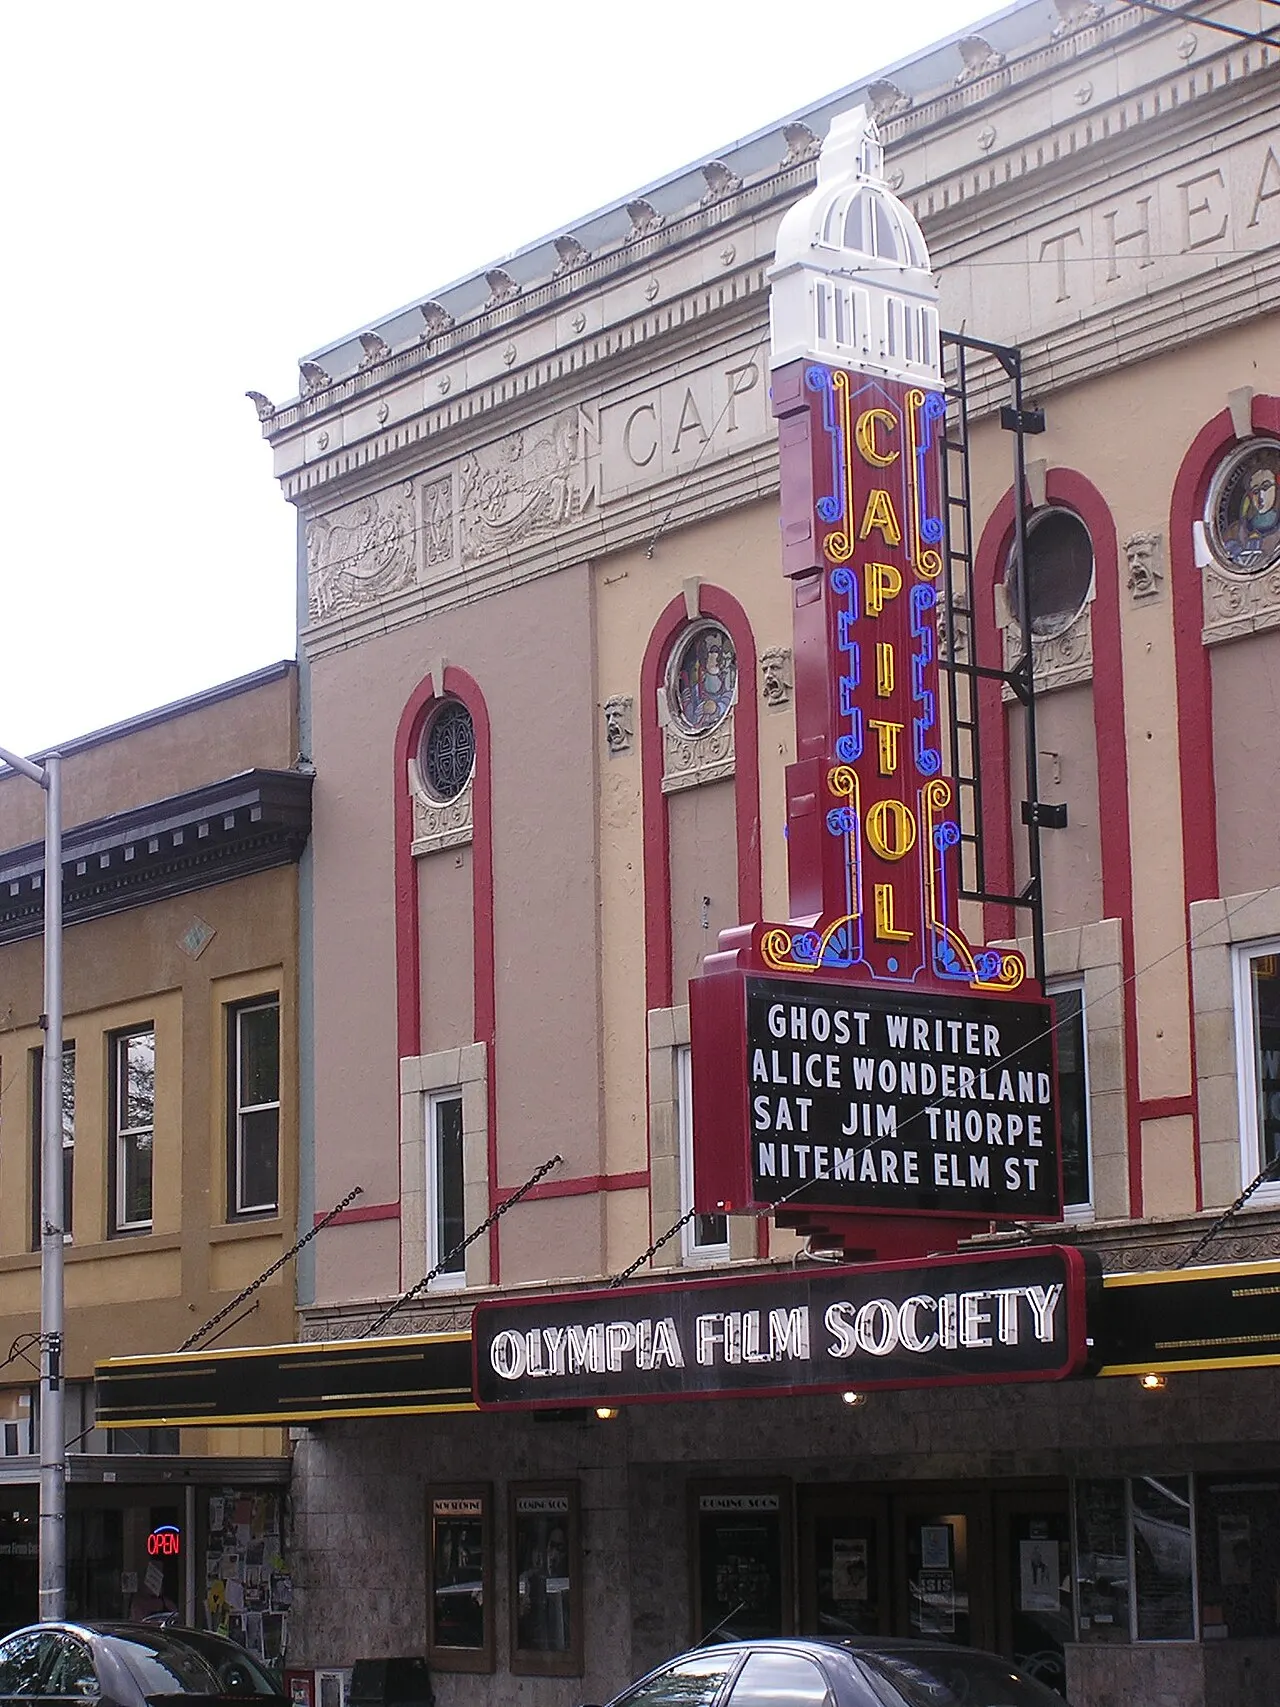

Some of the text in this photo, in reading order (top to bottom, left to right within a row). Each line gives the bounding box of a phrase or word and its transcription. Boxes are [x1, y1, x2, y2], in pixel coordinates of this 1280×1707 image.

[854, 406, 917, 943] CAPITOL
[768, 1003, 1001, 1057] GHOST WRITER
[753, 1048, 1051, 1105] ALICE WONDERLAND
[754, 1095, 1043, 1148] SAT JIM THORPE
[758, 1142, 1039, 1191] NITEMARE ELM ST
[490, 1283, 1064, 1380] OLYMPIA FILM SOCIETY
[147, 1533, 180, 1555] OPEN
